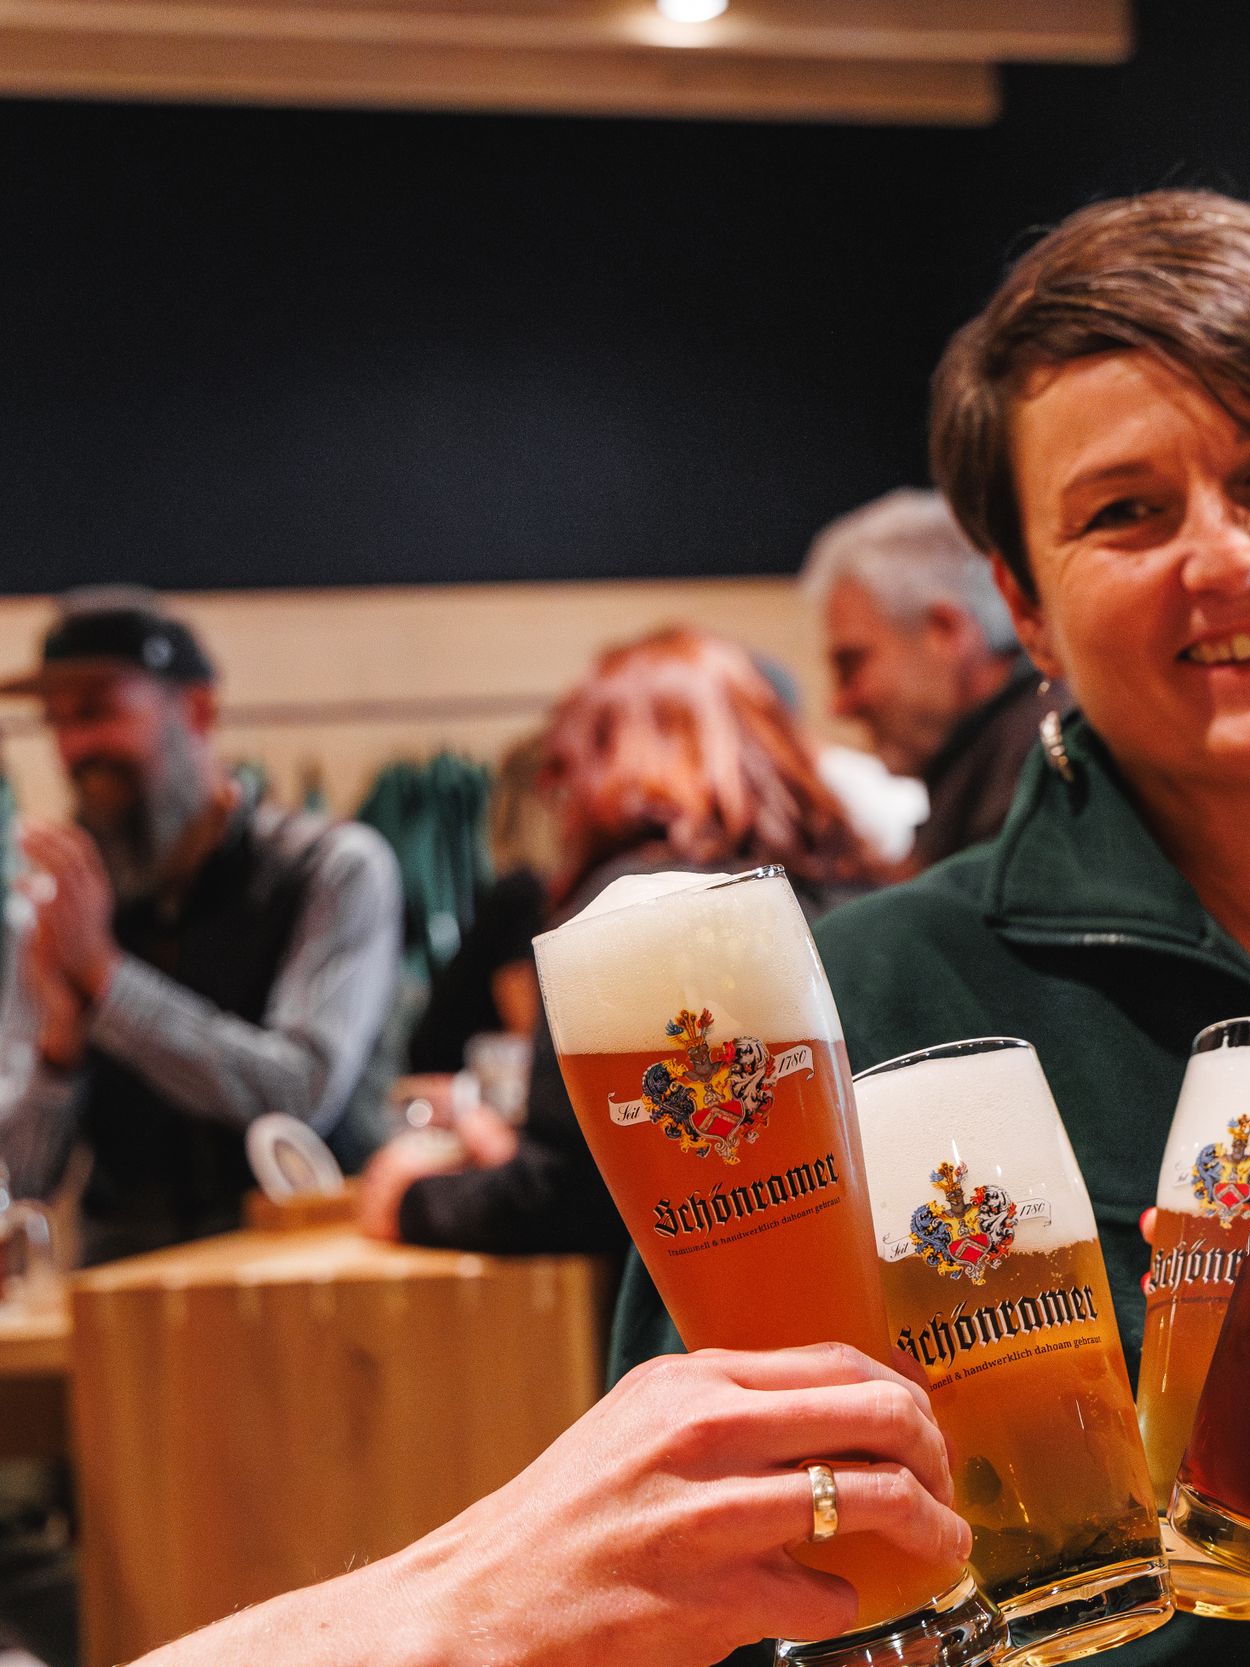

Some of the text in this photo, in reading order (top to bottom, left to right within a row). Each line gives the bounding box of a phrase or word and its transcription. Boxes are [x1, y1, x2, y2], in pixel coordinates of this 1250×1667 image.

[616, 1049, 807, 1121] Seit 1780
[651, 1152, 840, 1239] Schönramer
[720, 1217, 781, 1246] handwerklich
[781, 1207, 815, 1226] dahoam
[954, 1371, 962, 1381] &
[963, 1347, 1034, 1379] handwerklich
[1034, 1340, 1073, 1356] dahoam
